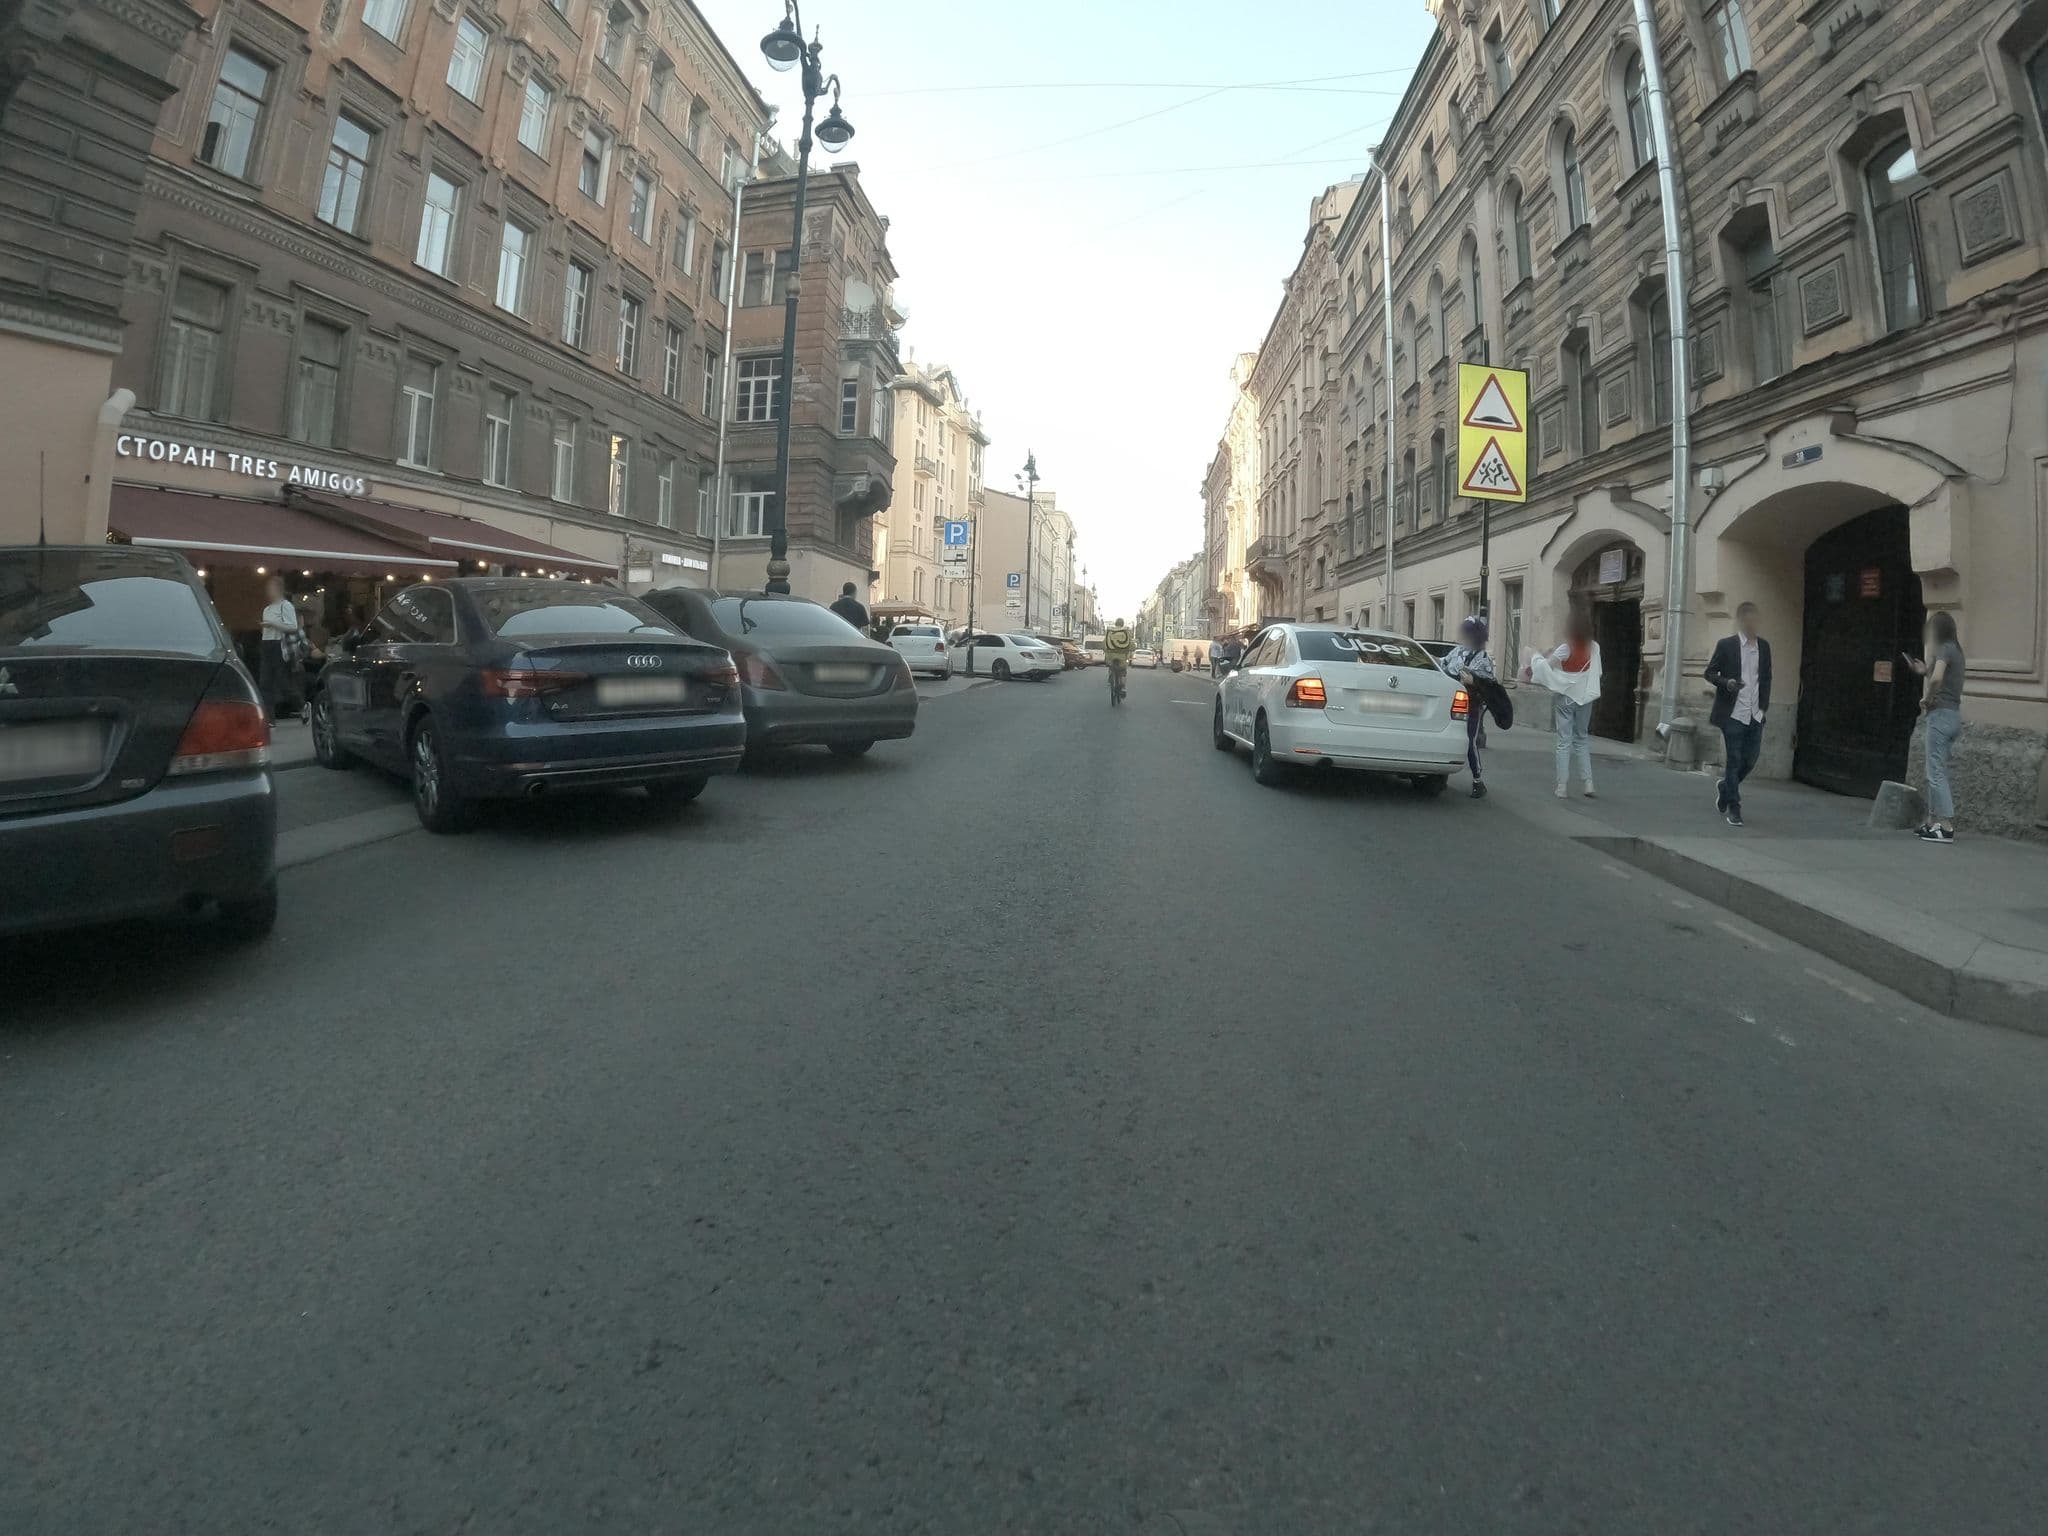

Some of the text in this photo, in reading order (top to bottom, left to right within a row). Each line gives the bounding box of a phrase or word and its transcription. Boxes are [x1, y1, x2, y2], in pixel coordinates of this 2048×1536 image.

[116, 435, 367, 495] СТОРАН TRES AMIGOS
[950, 523, 964, 543] P
[1009, 574, 1019, 586] P
[1331, 637, 1410, 657] Uber
